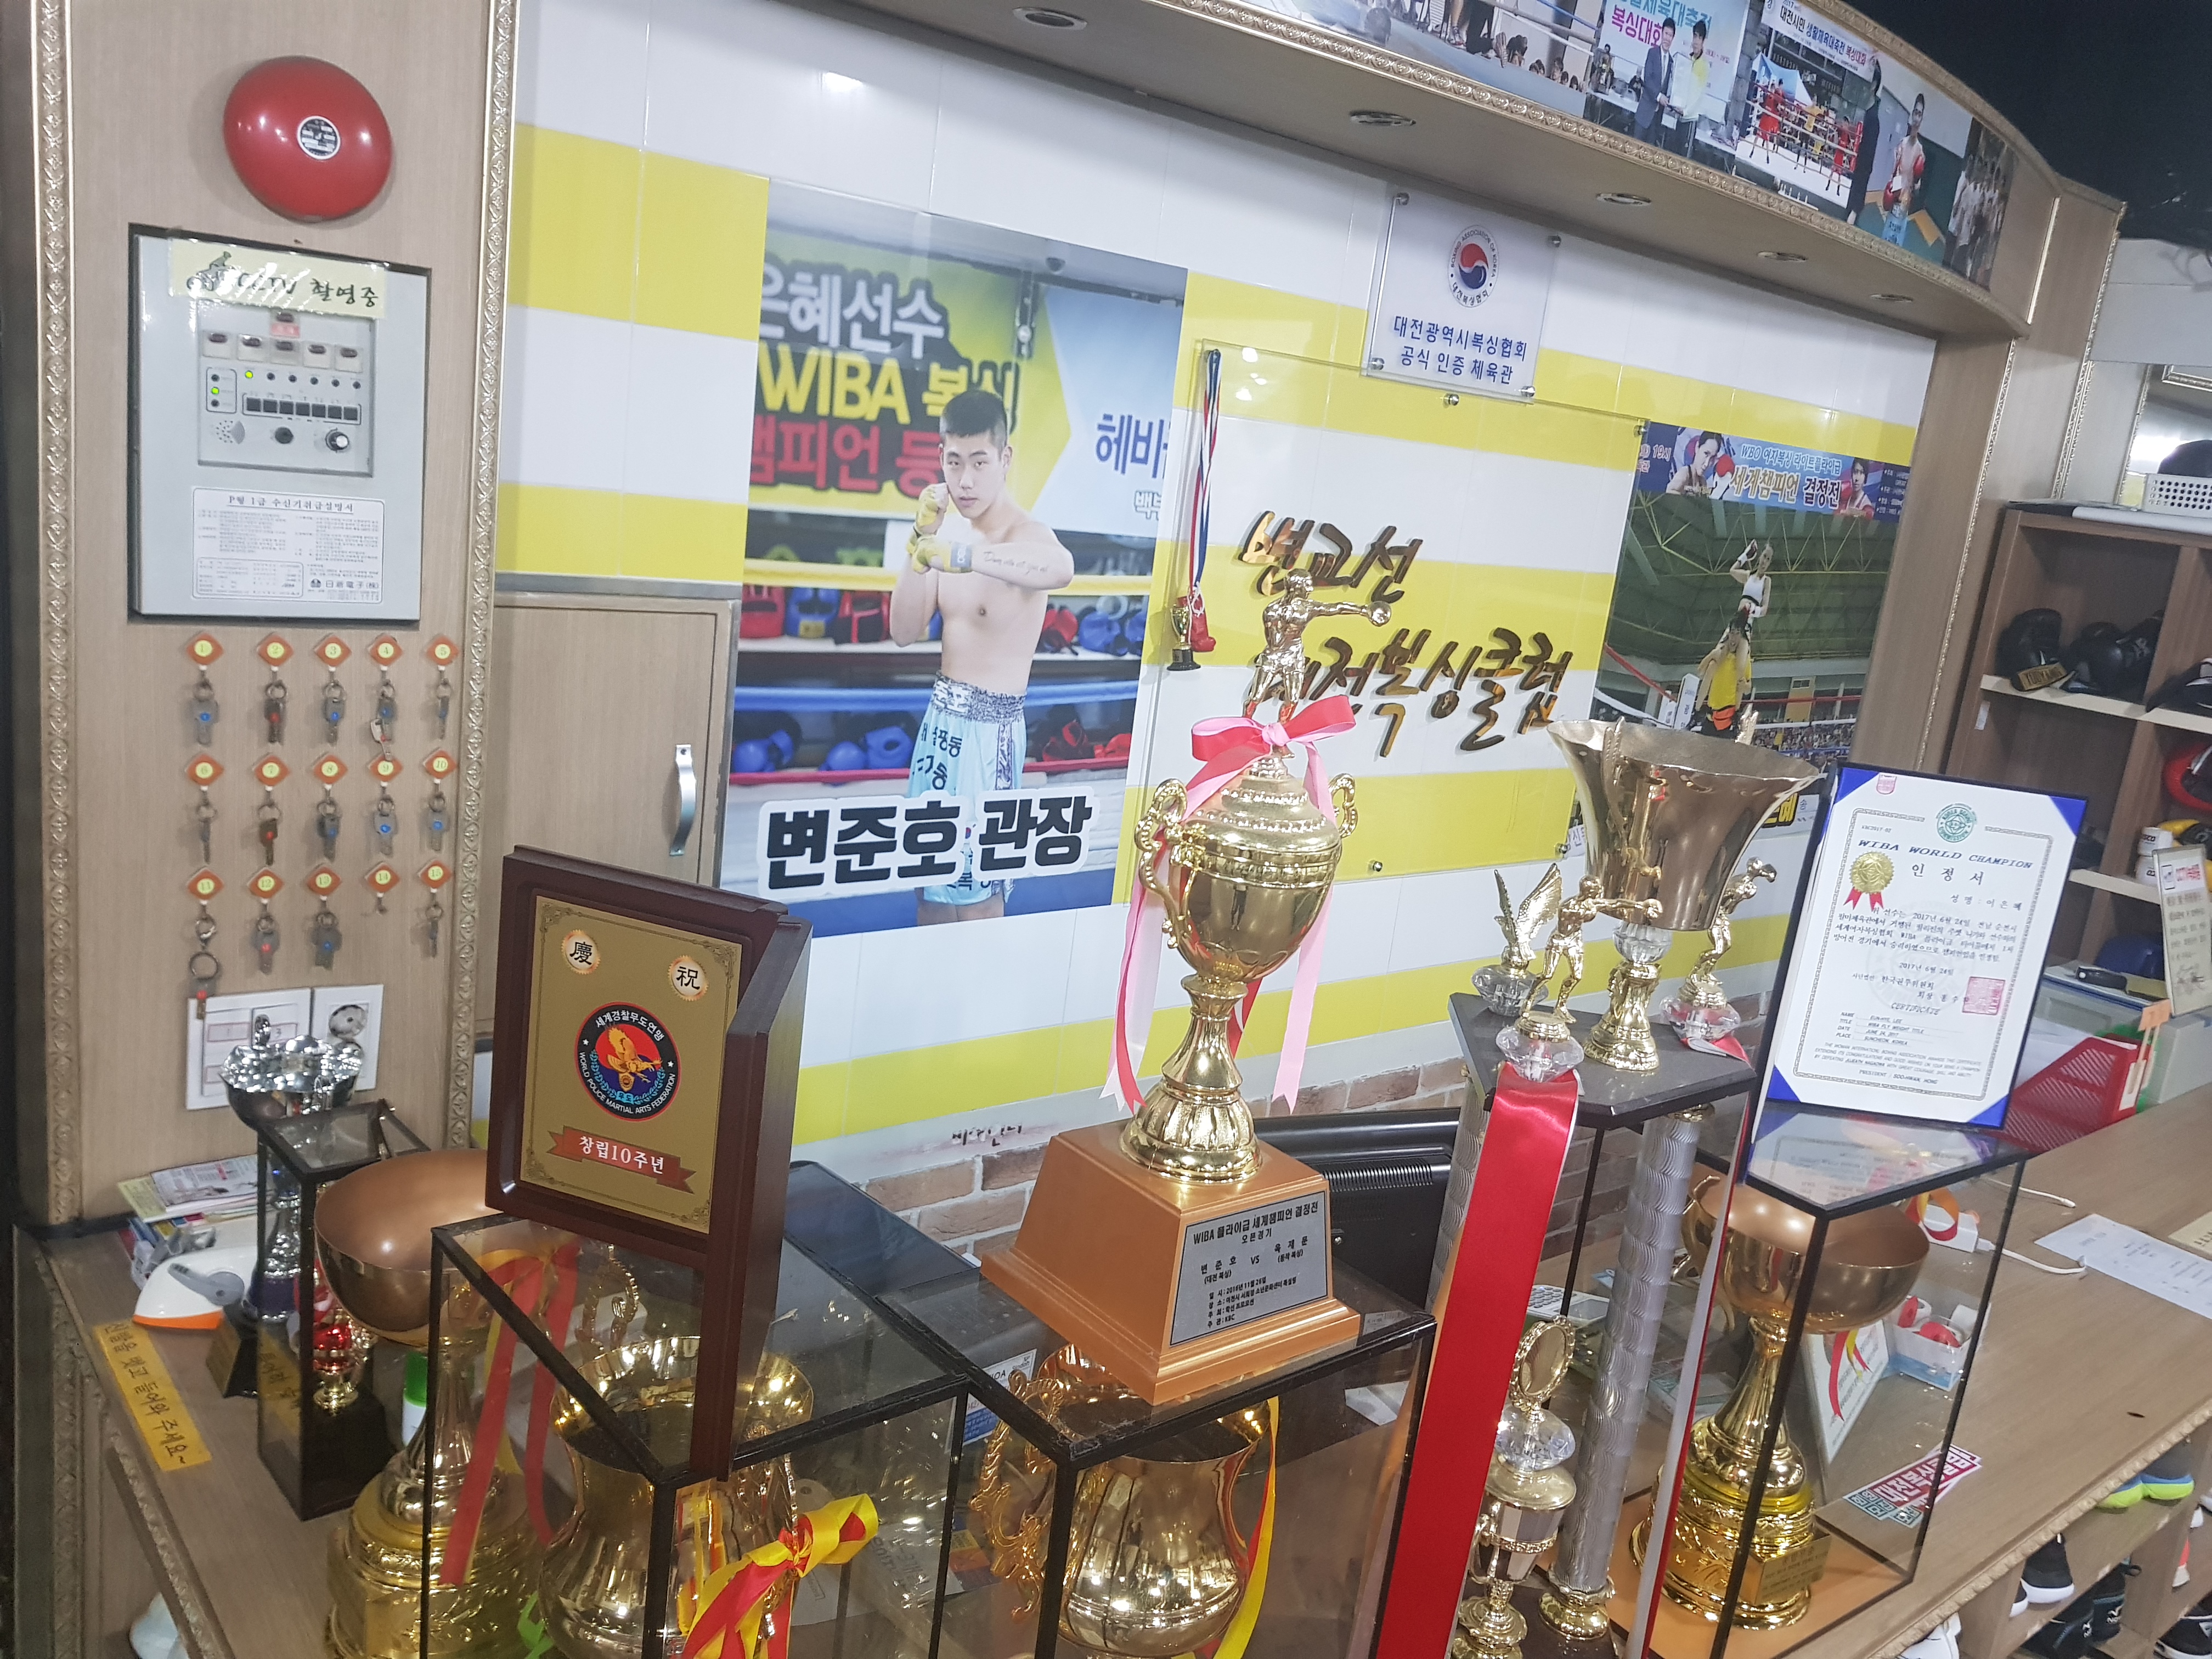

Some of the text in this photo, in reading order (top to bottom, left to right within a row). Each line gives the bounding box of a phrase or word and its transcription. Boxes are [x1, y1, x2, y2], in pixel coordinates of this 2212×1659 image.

[1780, 5, 1806, 32] 대전시민
[1806, 22, 1845, 55] 생활체육대축전
[1846, 45, 1867, 66] 복싱대회
[311, 278, 379, 307] 촬영중
[1393, 315, 1527, 362] 대전광역시복싱협회
[758, 341, 911, 425] WIBA
[1401, 346, 1514, 385] 공식 인증 체육관
[1652, 444, 1672, 461] 19시
[1741, 443, 1842, 475] WBO 여자복싱 라이트플라이급
[1730, 466, 1841, 508] 세계챔피언 결정전
[768, 799, 960, 890] 변준호
[978, 795, 1093, 872] 관장
[1858, 839, 2033, 869] WIBA WORLD CHAMPION
[675, 965, 701, 990] 祝
[595, 1010, 665, 1041] 세계경찰무도연맹
[1891, 1002, 1942, 1015] CERTIFICATE
[579, 1052, 676, 1114] WORLD POLICE MARTIAL ARTS FEDERATION
[579, 1135, 664, 1175] 창립10주년
[1193, 1200, 1318, 1245] WIBA 플라이급 세계챔피언 결정전
[1242, 1228, 1272, 1244] 오픈경기
[1250, 1255, 1260, 1265] VS
